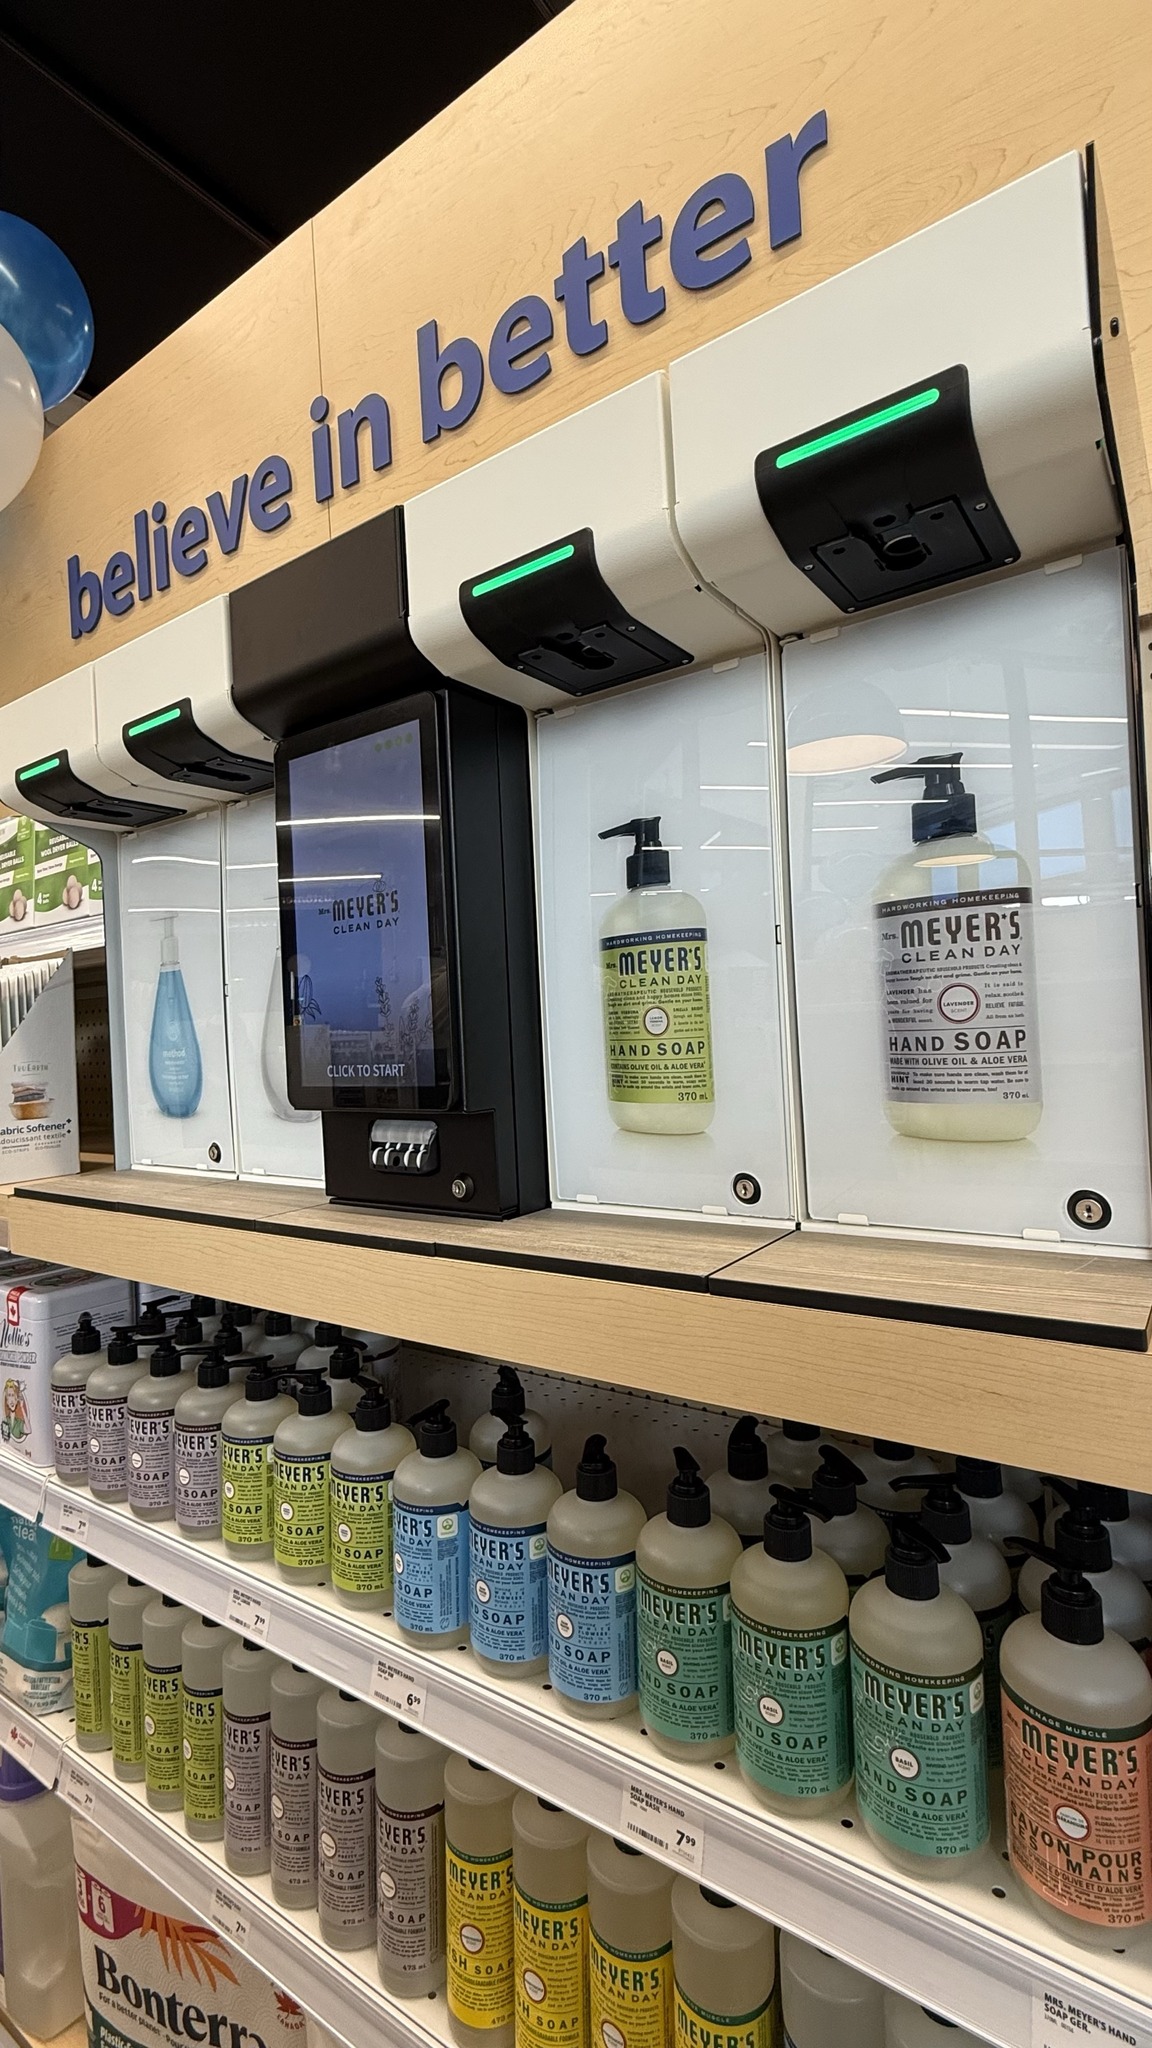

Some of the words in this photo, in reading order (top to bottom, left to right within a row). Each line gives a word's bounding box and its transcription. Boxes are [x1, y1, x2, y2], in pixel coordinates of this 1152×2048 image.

[68, 453, 294, 640] believe
[310, 394, 392, 504] in
[416, 108, 829, 446] better
[37, 892, 42, 905] 4
[881, 899, 947, 914] HARDWORKING
[952, 892, 1019, 904] HOMEKEEPING
[332, 890, 399, 922] MEYER'S
[333, 921, 370, 935] CLEAN
[376, 916, 400, 929] DAY
[881, 932, 899, 941] Mrs.
[900, 910, 1020, 949] MEYER'S
[901, 947, 974, 964] CLEAN
[984, 944, 1021, 958] DAY
[619, 946, 702, 976] MEYER'S
[619, 976, 671, 989] CLEAN
[677, 974, 702, 985] DAY
[889, 1036, 944, 1052] HAND
[953, 1029, 1026, 1051] SOAP
[609, 1044, 650, 1057] HAND
[656, 1041, 705, 1056] SOAP
[890, 1057, 903, 1065] MADE
[904, 1057, 920, 1066] WITH
[922, 1057, 948, 1066] OLIVE
[951, 1057, 968, 1066] OIL
[970, 1057, 978, 1065] &
[981, 1055, 1005, 1064] ALOE
[1007, 1054, 1028, 1063] VERA
[327, 1064, 355, 1077] CLICK
[356, 1064, 371, 1077] TO
[373, 1063, 405, 1077] START
[630, 1063, 649, 1071] OLIVE
[650, 1063, 662, 1071] OIL
[678, 1091, 697, 1101] 370
[1002, 1091, 1021, 1099] 370
[26, 1123, 67, 1133] Softener
[0, 1136, 41, 1145] doucissant
[43, 1132, 67, 1140] textile
[94, 1456, 126, 1465] SOAP
[196, 1450, 217, 1458] DAY
[242, 1464, 263, 1472] DAY
[136, 1471, 170, 1481] SOAP
[184, 1488, 218, 1499] SOAP
[302, 1483, 324, 1491] DAY
[229, 1505, 262, 1514] SOAP
[359, 1504, 384, 1512] DAY
[286, 1525, 324, 1536] SOAP
[482, 1525, 526, 1535] HOMEKEEPING
[408, 1537, 432, 1547] DAY
[344, 1548, 384, 1560] SOAP
[564, 1555, 611, 1566] HOMEKEEPING
[497, 1561, 524, 1571] DAY
[397, 1582, 433, 1598] SOAP
[667, 1586, 718, 1596] HOMEKEEPING
[581, 1595, 610, 1604] DAY
[641, 1587, 718, 1625] MEYER'S
[481, 1611, 525, 1626] SOAP
[640, 1608, 681, 1636] CLEAN
[688, 1626, 718, 1637] DAY
[770, 1629, 827, 1638] HOMEKEEPING
[564, 1644, 611, 1663] SOAP
[738, 1625, 826, 1671] MEYER'S
[660, 1656, 674, 1668] BASIL
[739, 1653, 786, 1681] CLEAN
[794, 1670, 826, 1683] DAY
[904, 1675, 965, 1686] HOMEKEEPING
[583, 1692, 600, 1701] 370
[666, 1682, 719, 1700] SOAP
[864, 1669, 965, 1720] MEYER'S
[865, 1698, 923, 1731] CLEAN
[931, 1719, 965, 1733] DAY
[690, 1731, 708, 1740] 370
[771, 1732, 828, 1750] SOAP
[150, 1744, 179, 1754] SOAP
[1022, 1718, 1138, 1777] MEYER'S
[785, 1754, 805, 1764] ALOE
[895, 1756, 914, 1768] BASIL
[187, 1769, 215, 1781] SOAP
[1022, 1747, 1091, 1788] CLEAN
[1101, 1777, 1138, 1791] DAY
[798, 1785, 817, 1795] 370
[630, 1784, 644, 1797] MRS.
[644, 1792, 667, 1809] MEYER'S
[668, 1804, 685, 1817] HAND
[905, 1788, 968, 1807] SOAP
[230, 1802, 261, 1812] SOAP
[645, 1801, 661, 1814] BASIL
[874, 1788, 896, 1809] OLIVE
[897, 1804, 910, 1817] OIL
[912, 1809, 919, 1818] &
[921, 1811, 944, 1822] ALOE
[277, 1832, 310, 1843] SOAP
[1010, 1800, 1070, 1858] SAVON
[1082, 1849, 1142, 1868] POUR
[401, 1845, 426, 1855] DAY
[936, 1845, 957, 1855] 370
[1010, 1813, 1038, 1851] LES
[1066, 1858, 1142, 1883] MAINS
[329, 1869, 365, 1881] SOAP
[1054, 1868, 1083, 1889] D'OLIVE
[1085, 1882, 1095, 1892] ET
[1097, 1883, 1124, 1894] D'ALOE
[489, 1886, 513, 1901] DAY
[98, 1895, 105, 1914] 6
[389, 1910, 427, 1924] SOAP
[1107, 1914, 1131, 1924] 370
[552, 1940, 578, 1951] DAY
[474, 1957, 513, 1975] SOAP
[631, 1991, 660, 2003] DAY
[536, 2016, 579, 2030] SOAP
[1044, 2003, 1069, 2021] SOAP
[1069, 2016, 1091, 2034] GER.
[1044, 1992, 1066, 2011] MRS.
[1068, 2005, 1107, 2032] MEYER'S
[1108, 2024, 1137, 2047] HAND
